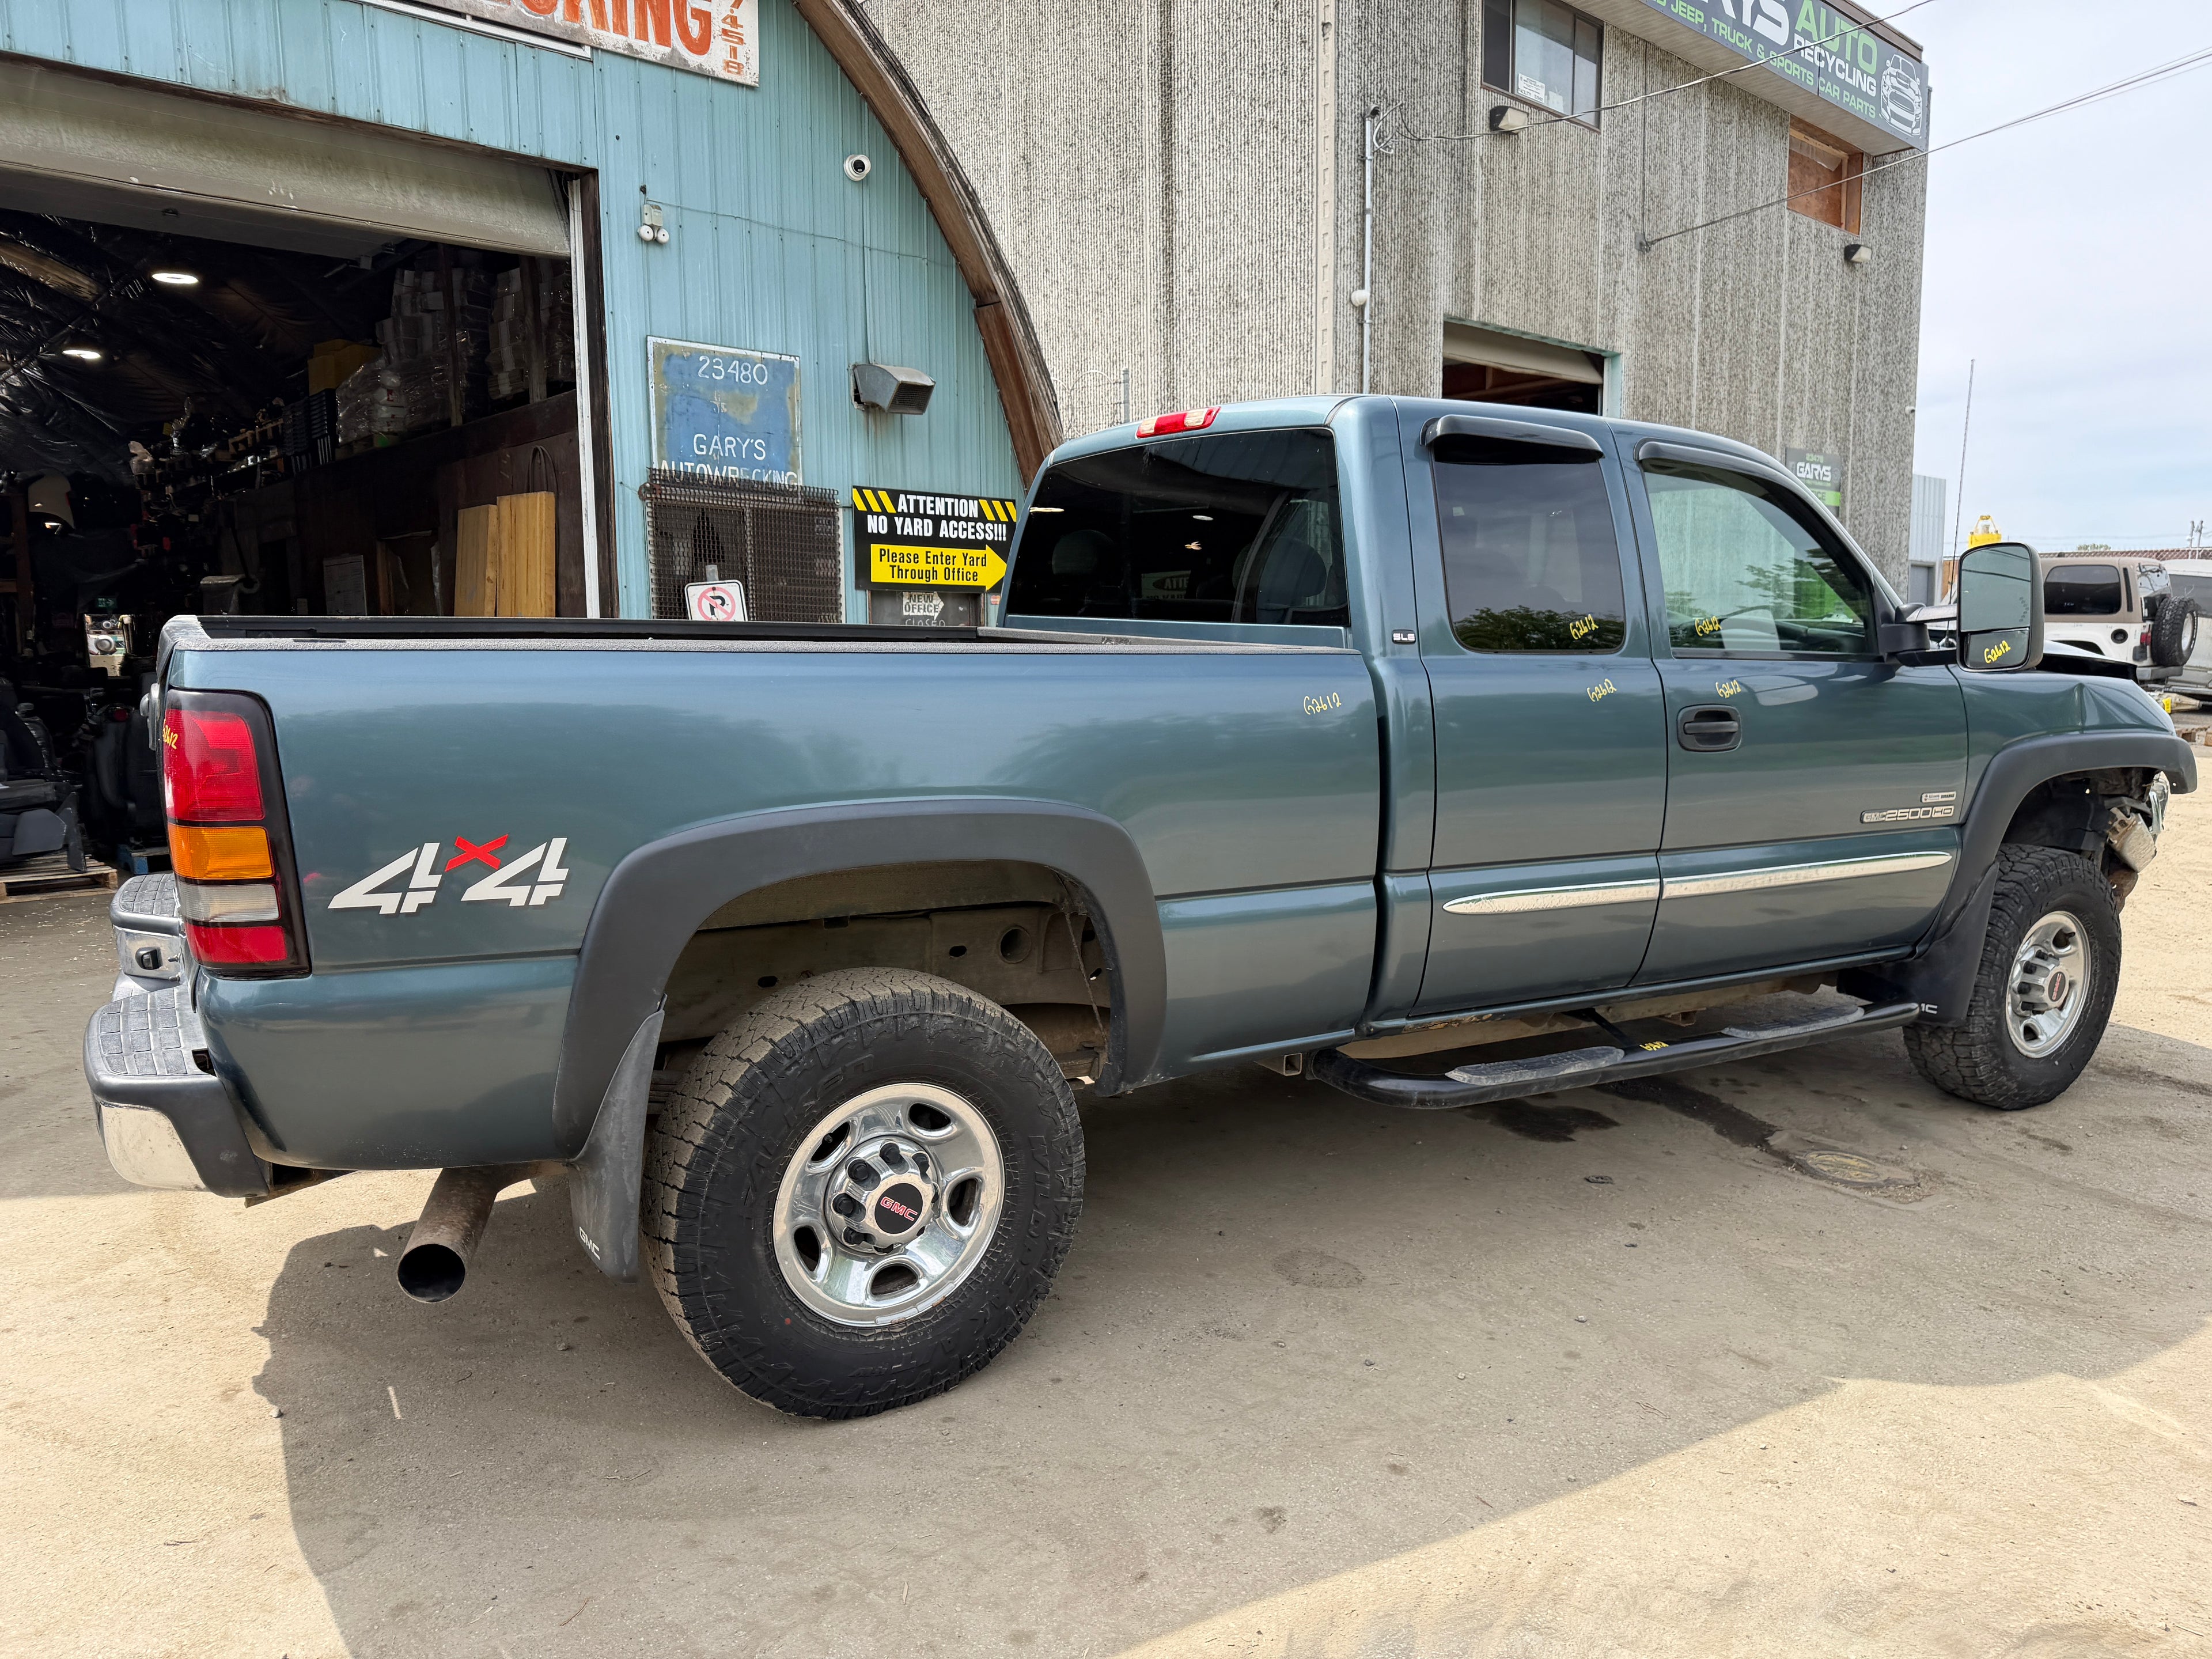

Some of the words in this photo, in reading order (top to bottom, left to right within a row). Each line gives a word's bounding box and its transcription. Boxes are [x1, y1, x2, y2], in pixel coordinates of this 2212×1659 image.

[1794, 0, 1877, 74] AUTO
[1711, 17, 1753, 54] TRUCK
[1756, 43, 1765, 59] &
[1770, 50, 1814, 86] SPORTS
[1819, 77, 1840, 100] CAR
[1843, 90, 1876, 119] PARTS
[1794, 33, 1877, 97] RECYCLING
[698, 355, 768, 385] 23480
[693, 433, 766, 460] GARY'S
[1797, 462, 1831, 482] GARYS
[897, 494, 978, 518] ATTENTION
[867, 515, 888, 534] NO
[894, 517, 933, 536] YARD
[940, 520, 1006, 541] ACCESS!!!
[879, 548, 919, 564] Please
[925, 551, 956, 566] Enter
[962, 553, 987, 567] Yard
[889, 565, 938, 582] Through
[944, 567, 978, 582] Office
[904, 603, 940, 613] OFFICE
[909, 593, 934, 603] NEW
[1393, 633, 1415, 641] SLE
[1984, 640, 2011, 664] G2612
[1587, 679, 1617, 702] G2612
[1303, 692, 1342, 715] G2612
[880, 1196, 918, 1221] GMC
[579, 1226, 600, 1260] GMC
